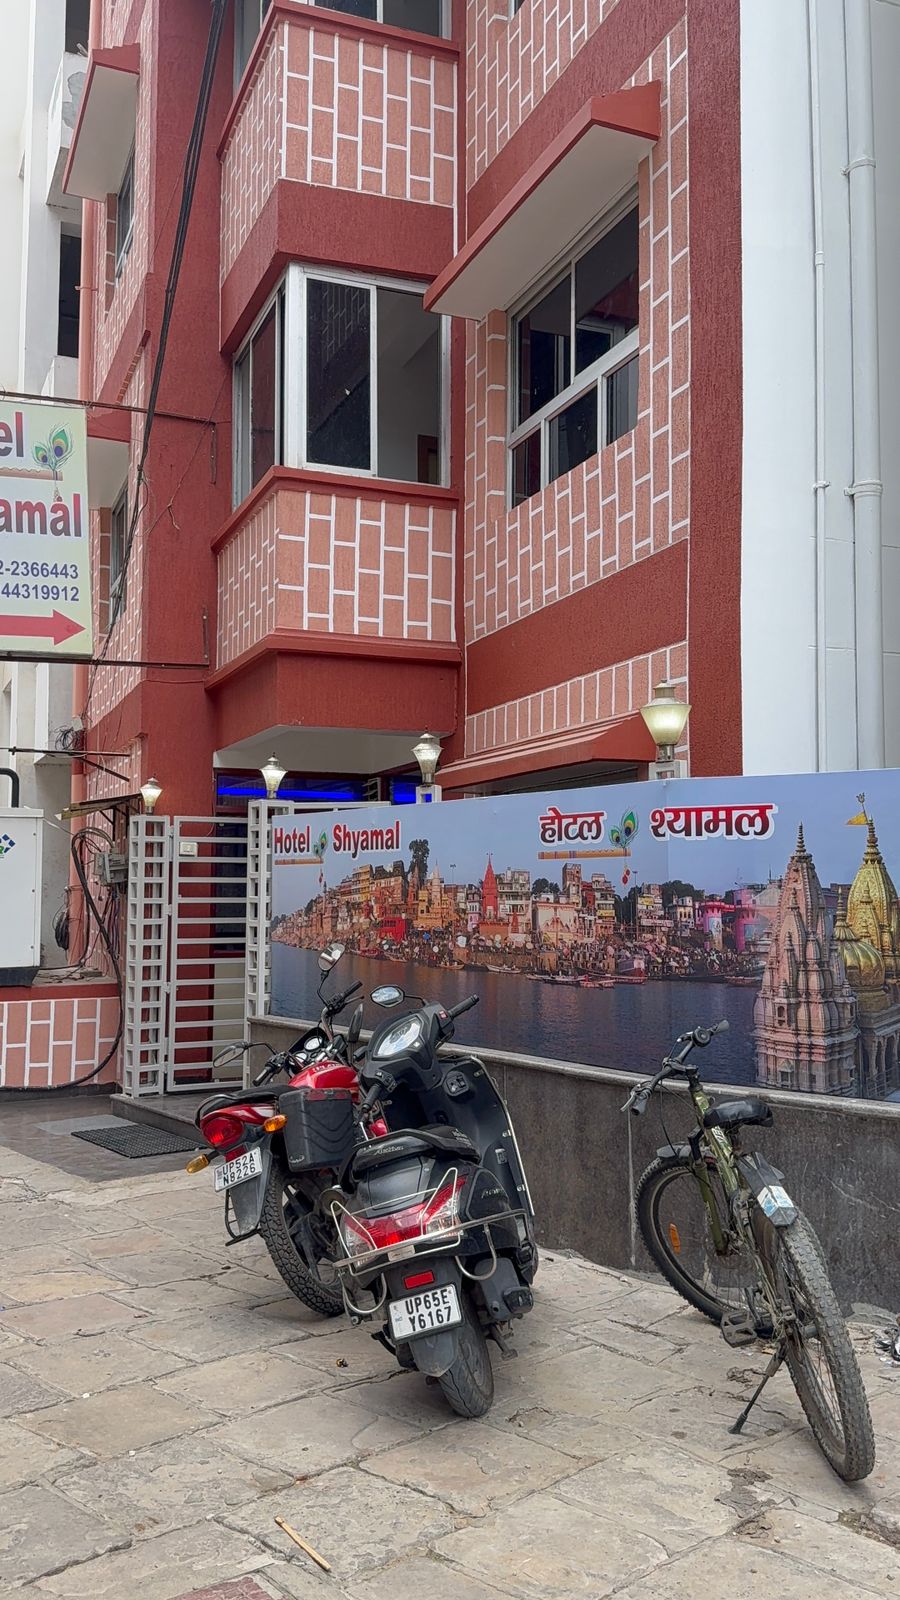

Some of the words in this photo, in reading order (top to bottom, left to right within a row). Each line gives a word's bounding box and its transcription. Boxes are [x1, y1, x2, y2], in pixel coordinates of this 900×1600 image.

[0, 412, 24, 457] el
[0, 493, 81, 537] amal
[1, 582, 79, 601] 44319912
[539, 806, 604, 843] होटल
[651, 804, 773, 837] श्यामल
[274, 825, 310, 854] Hotel
[333, 820, 400, 859] Shyamal
[222, 1152, 255, 1176] UP52A
[223, 1163, 256, 1186] N8226
[405, 1288, 450, 1315] UP65E
[408, 1305, 452, 1332] Y6167
